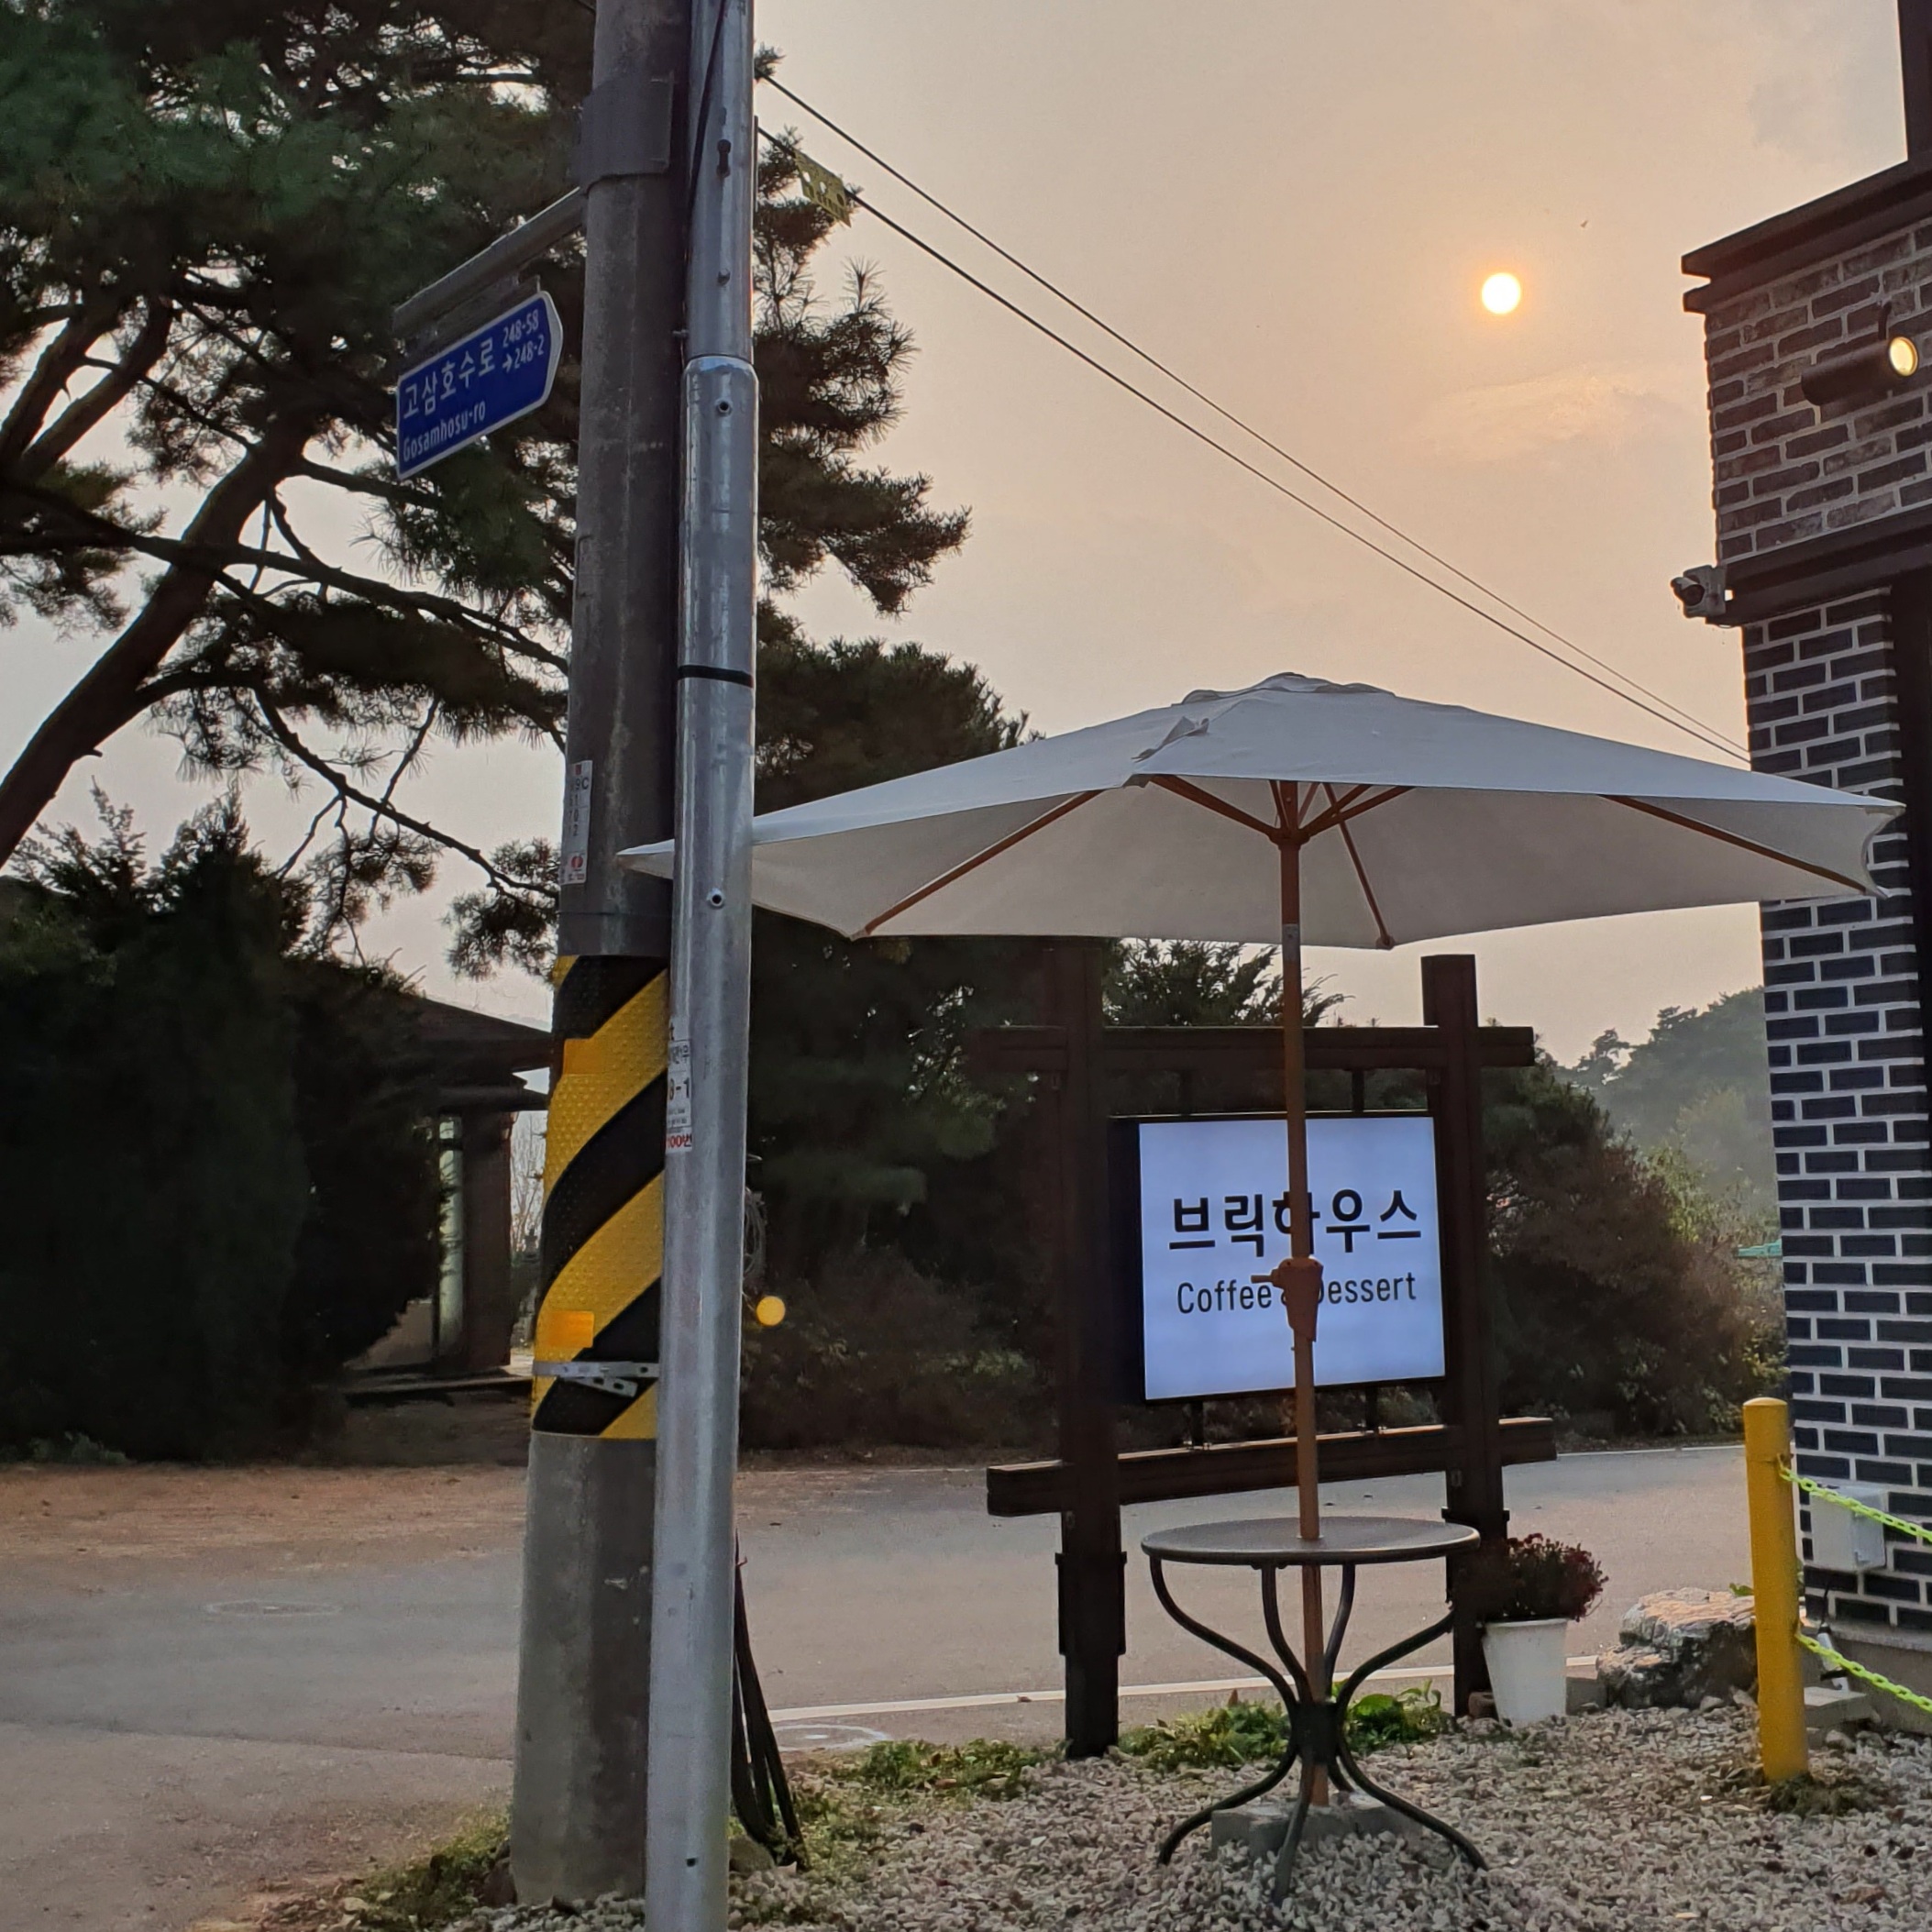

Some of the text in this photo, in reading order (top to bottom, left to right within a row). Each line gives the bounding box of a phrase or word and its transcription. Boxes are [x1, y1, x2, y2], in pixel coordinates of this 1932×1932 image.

[502, 309, 539, 348] 248-58
[514, 335, 545, 369] 248-2
[403, 337, 495, 418] 고삼호수로
[403, 401, 486, 462] Gosamhosu-ro
[1169, 1189, 1421, 1257] 브릭하우스
[1177, 1279, 1273, 1314] Coffee
[1315, 1272, 1417, 1305] essert
